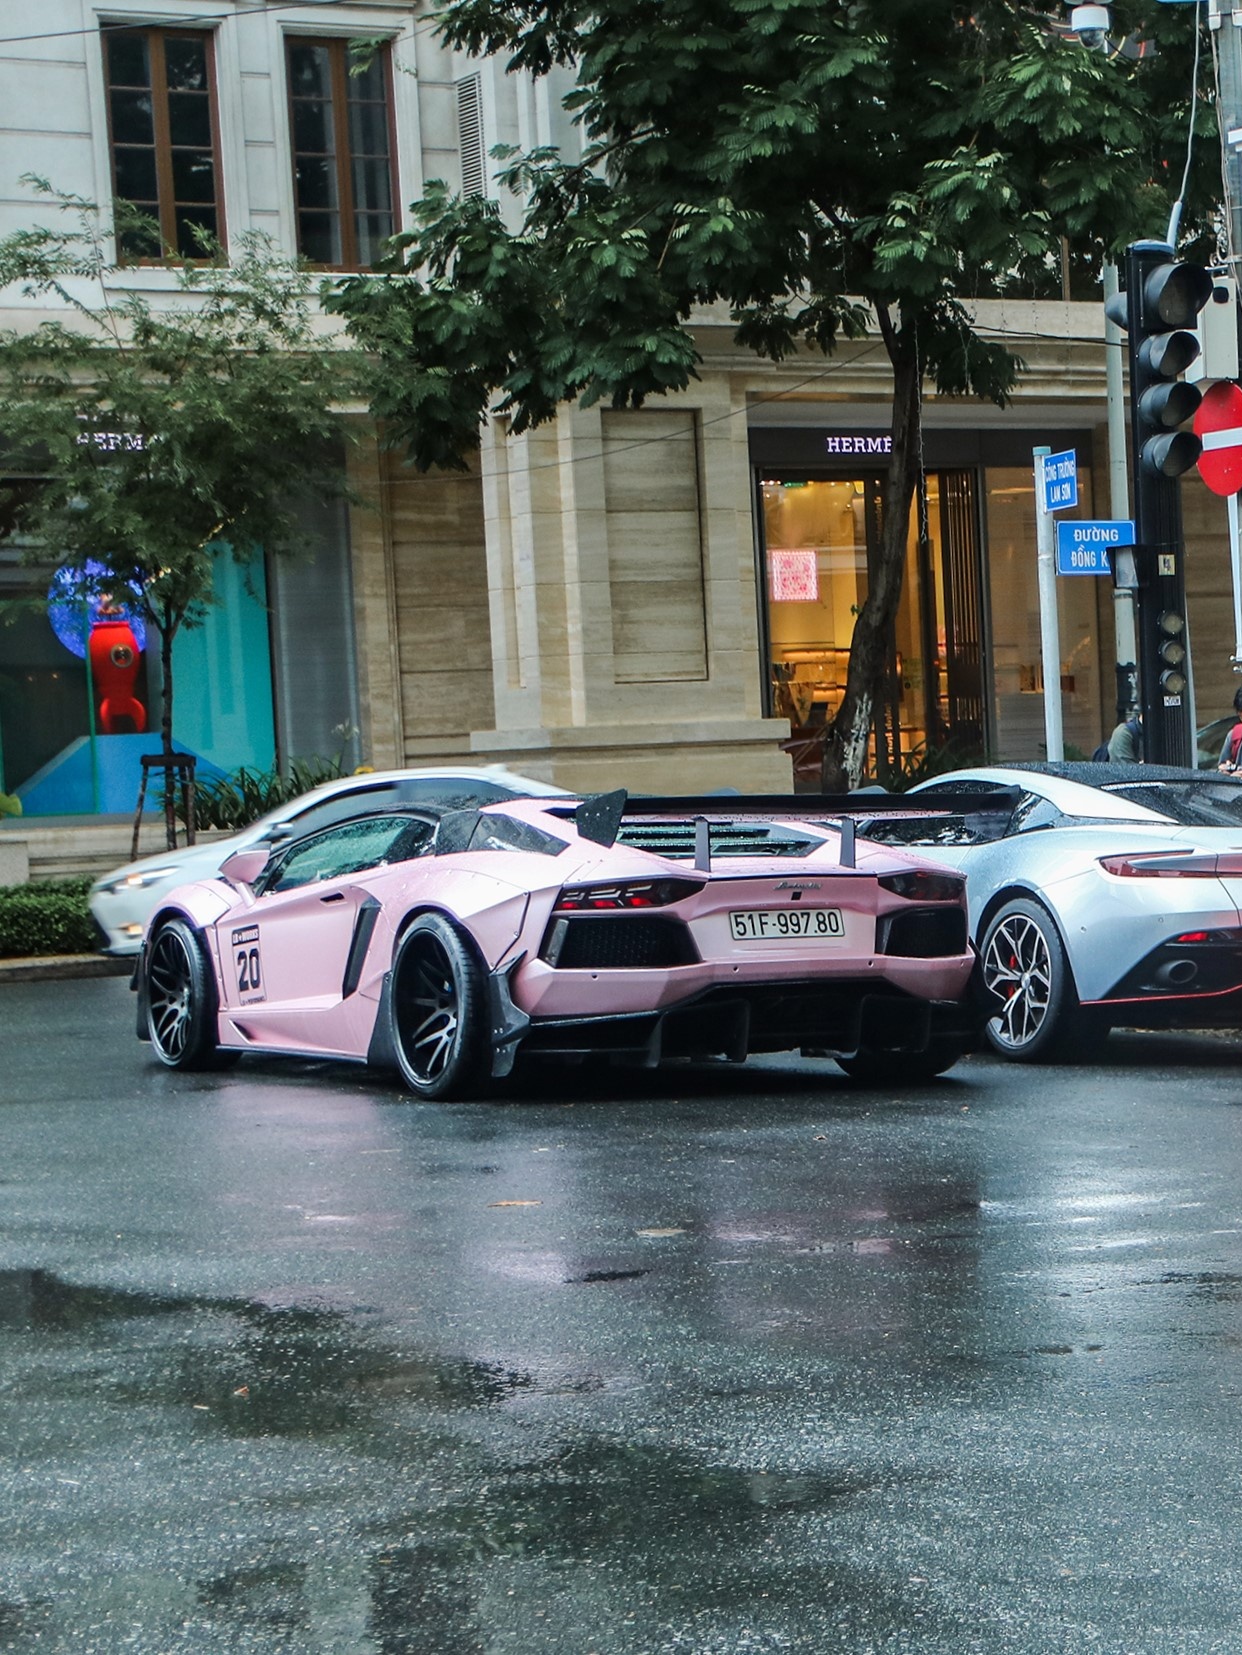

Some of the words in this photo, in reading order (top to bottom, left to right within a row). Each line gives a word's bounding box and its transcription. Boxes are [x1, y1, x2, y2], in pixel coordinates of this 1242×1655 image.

[826, 435, 892, 453] HERMÈ
[1074, 526, 1119, 542] ĐƯỜNG
[1071, 544, 1096, 568] ĐỒNG
[733, 911, 840, 937] 51F-997.80
[237, 947, 261, 992] 20
